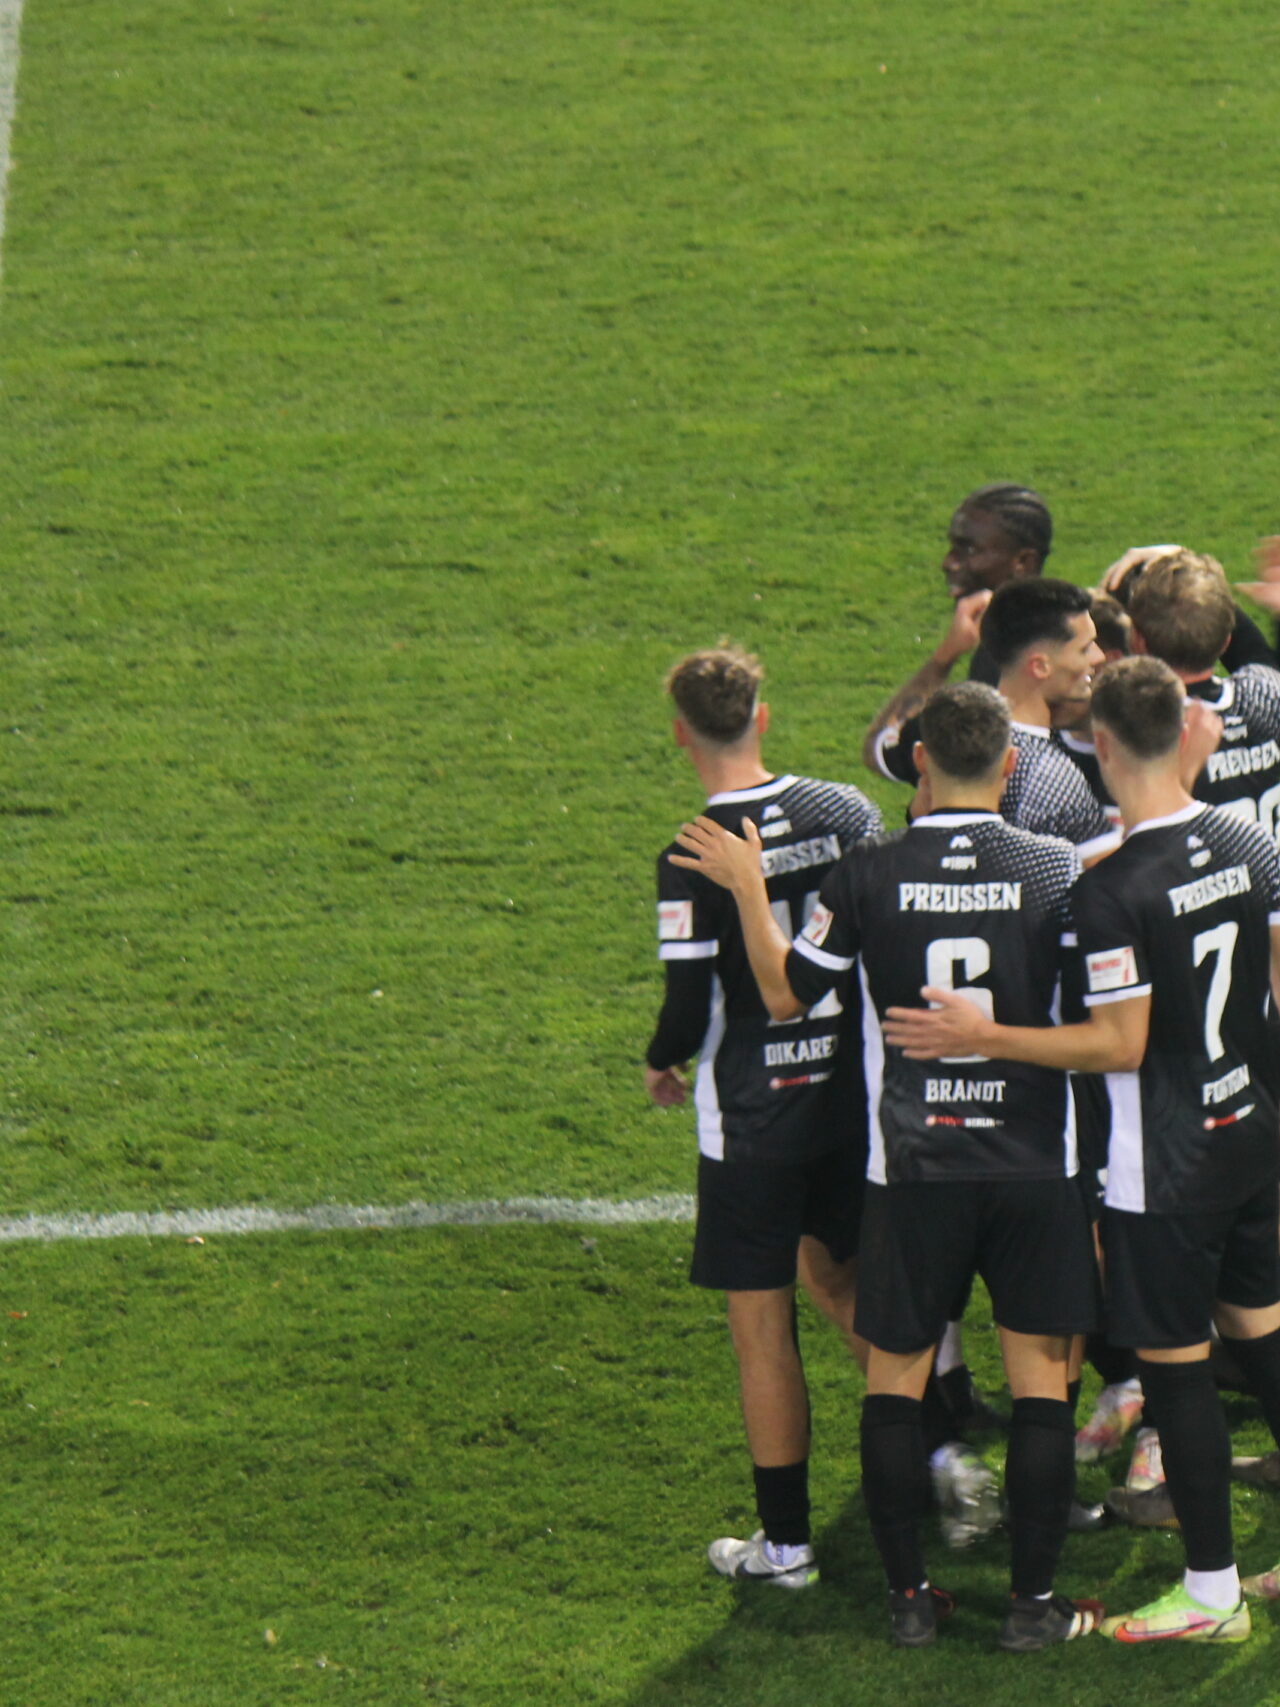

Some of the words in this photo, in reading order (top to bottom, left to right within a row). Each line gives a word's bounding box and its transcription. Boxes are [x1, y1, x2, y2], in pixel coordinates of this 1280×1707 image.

[761, 834, 842, 878] EUSSEN
[898, 882, 1023, 913] PREUSSEN
[1167, 863, 1252, 918] PREUSSEN
[926, 936, 996, 1064] 6
[1193, 920, 1239, 1064] 7
[764, 1034, 838, 1068] DIKARE
[925, 1078, 1006, 1103] BRANDT
